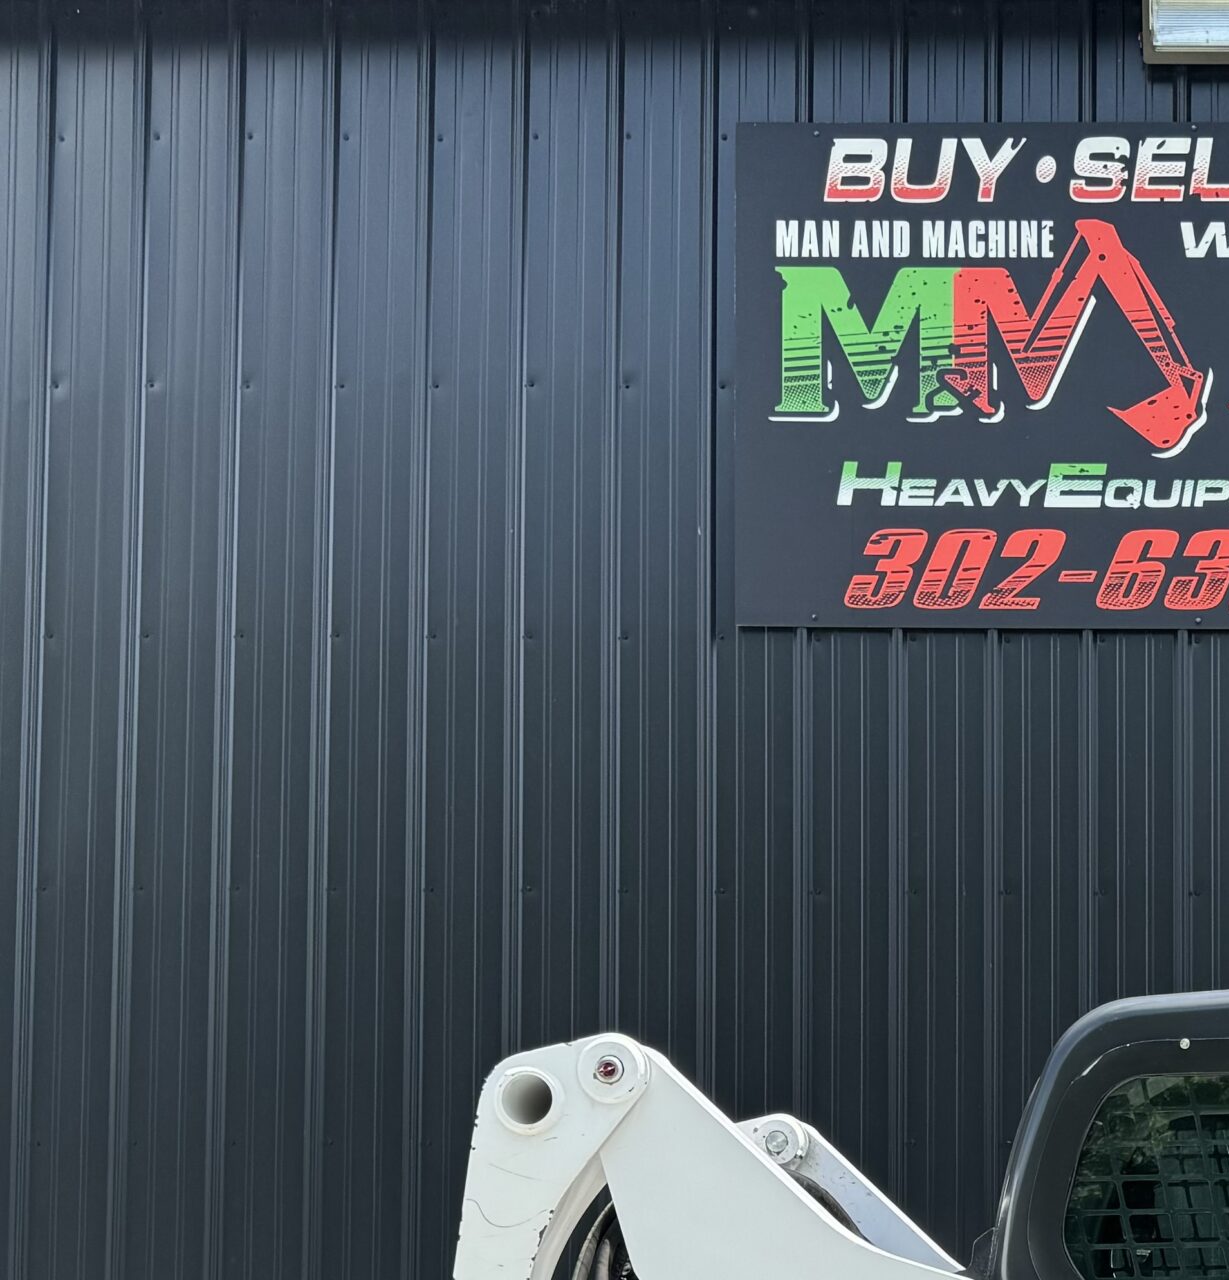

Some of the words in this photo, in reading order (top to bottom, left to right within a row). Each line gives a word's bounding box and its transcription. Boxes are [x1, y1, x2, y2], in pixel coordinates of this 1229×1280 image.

[823, 136, 1027, 202] BUY
[775, 219, 840, 258] MAN
[851, 219, 911, 258] AND
[922, 219, 1055, 258] MACHINE
